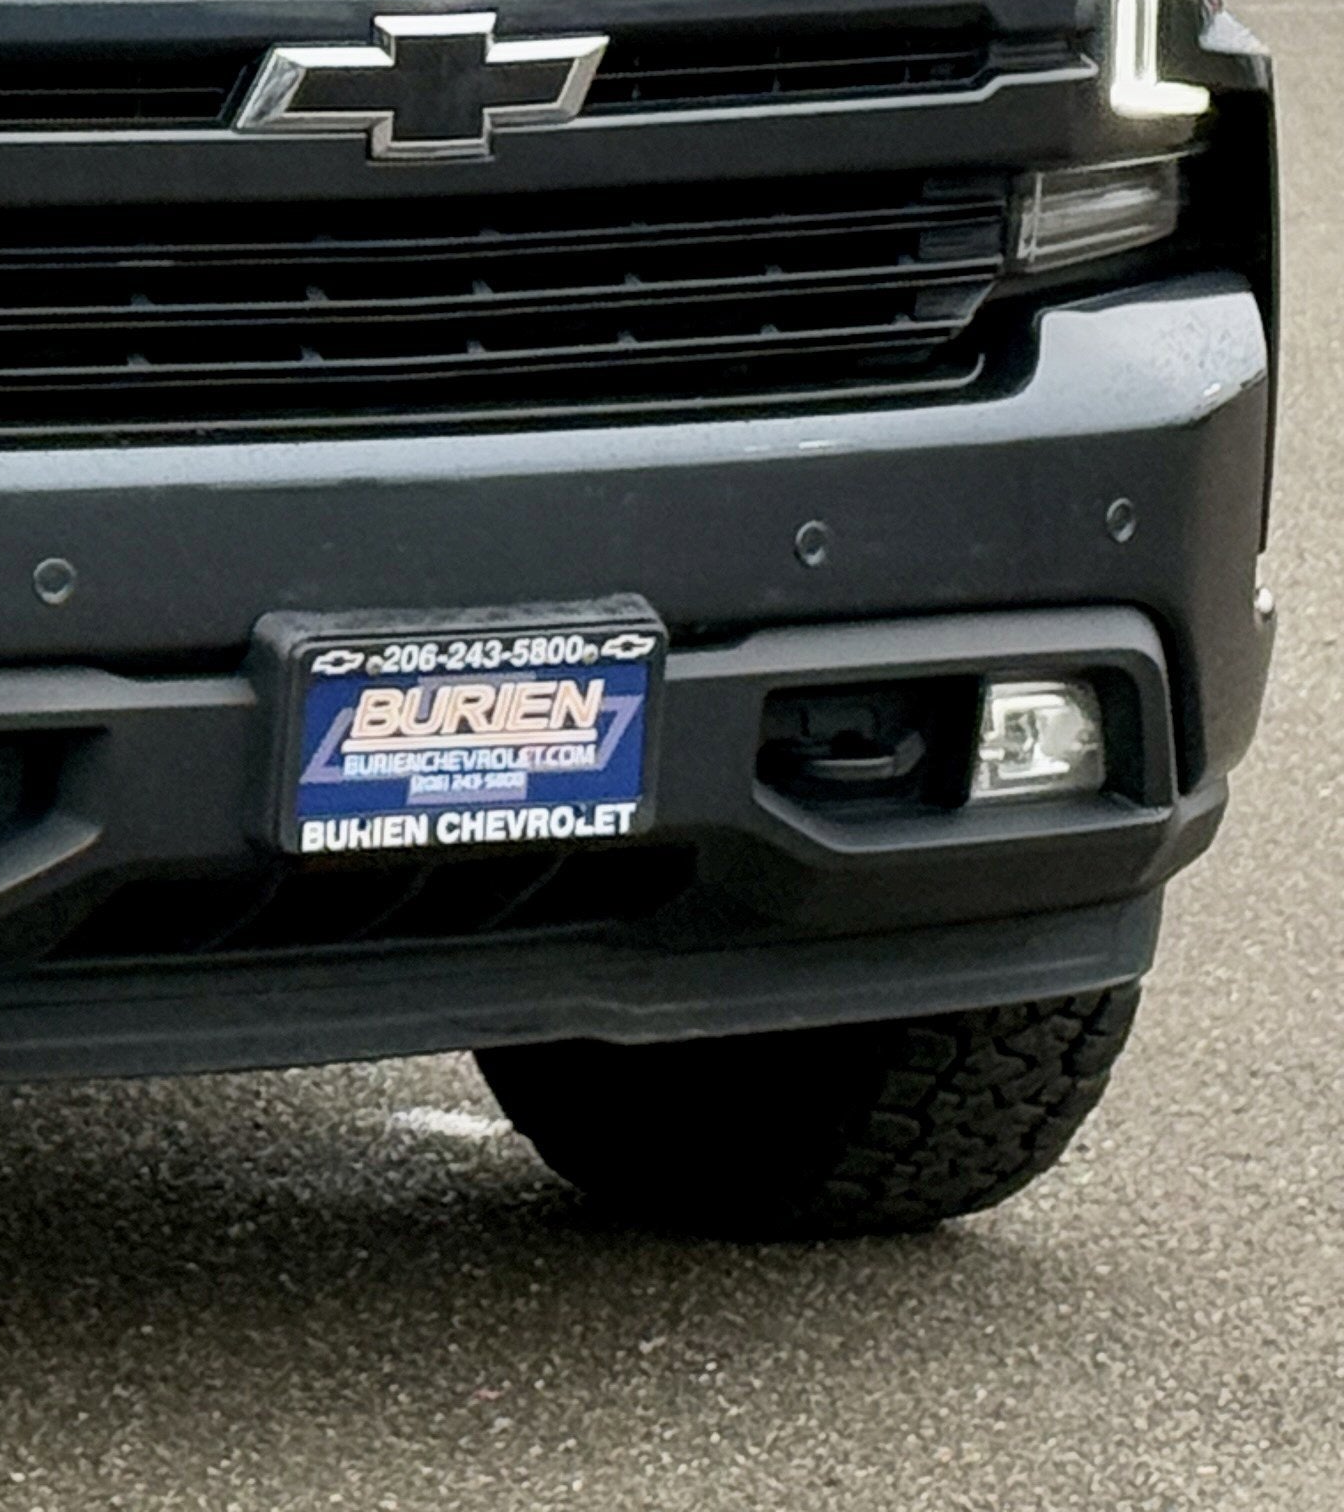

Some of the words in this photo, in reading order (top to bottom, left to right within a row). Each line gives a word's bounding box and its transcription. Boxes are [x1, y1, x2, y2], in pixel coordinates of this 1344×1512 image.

[383, 636, 583, 671] 206-243-5800
[351, 680, 603, 738] BURIEN
[345, 745, 595, 776] BURIENCHEVROLET.COM
[302, 814, 428, 852] BURIEN
